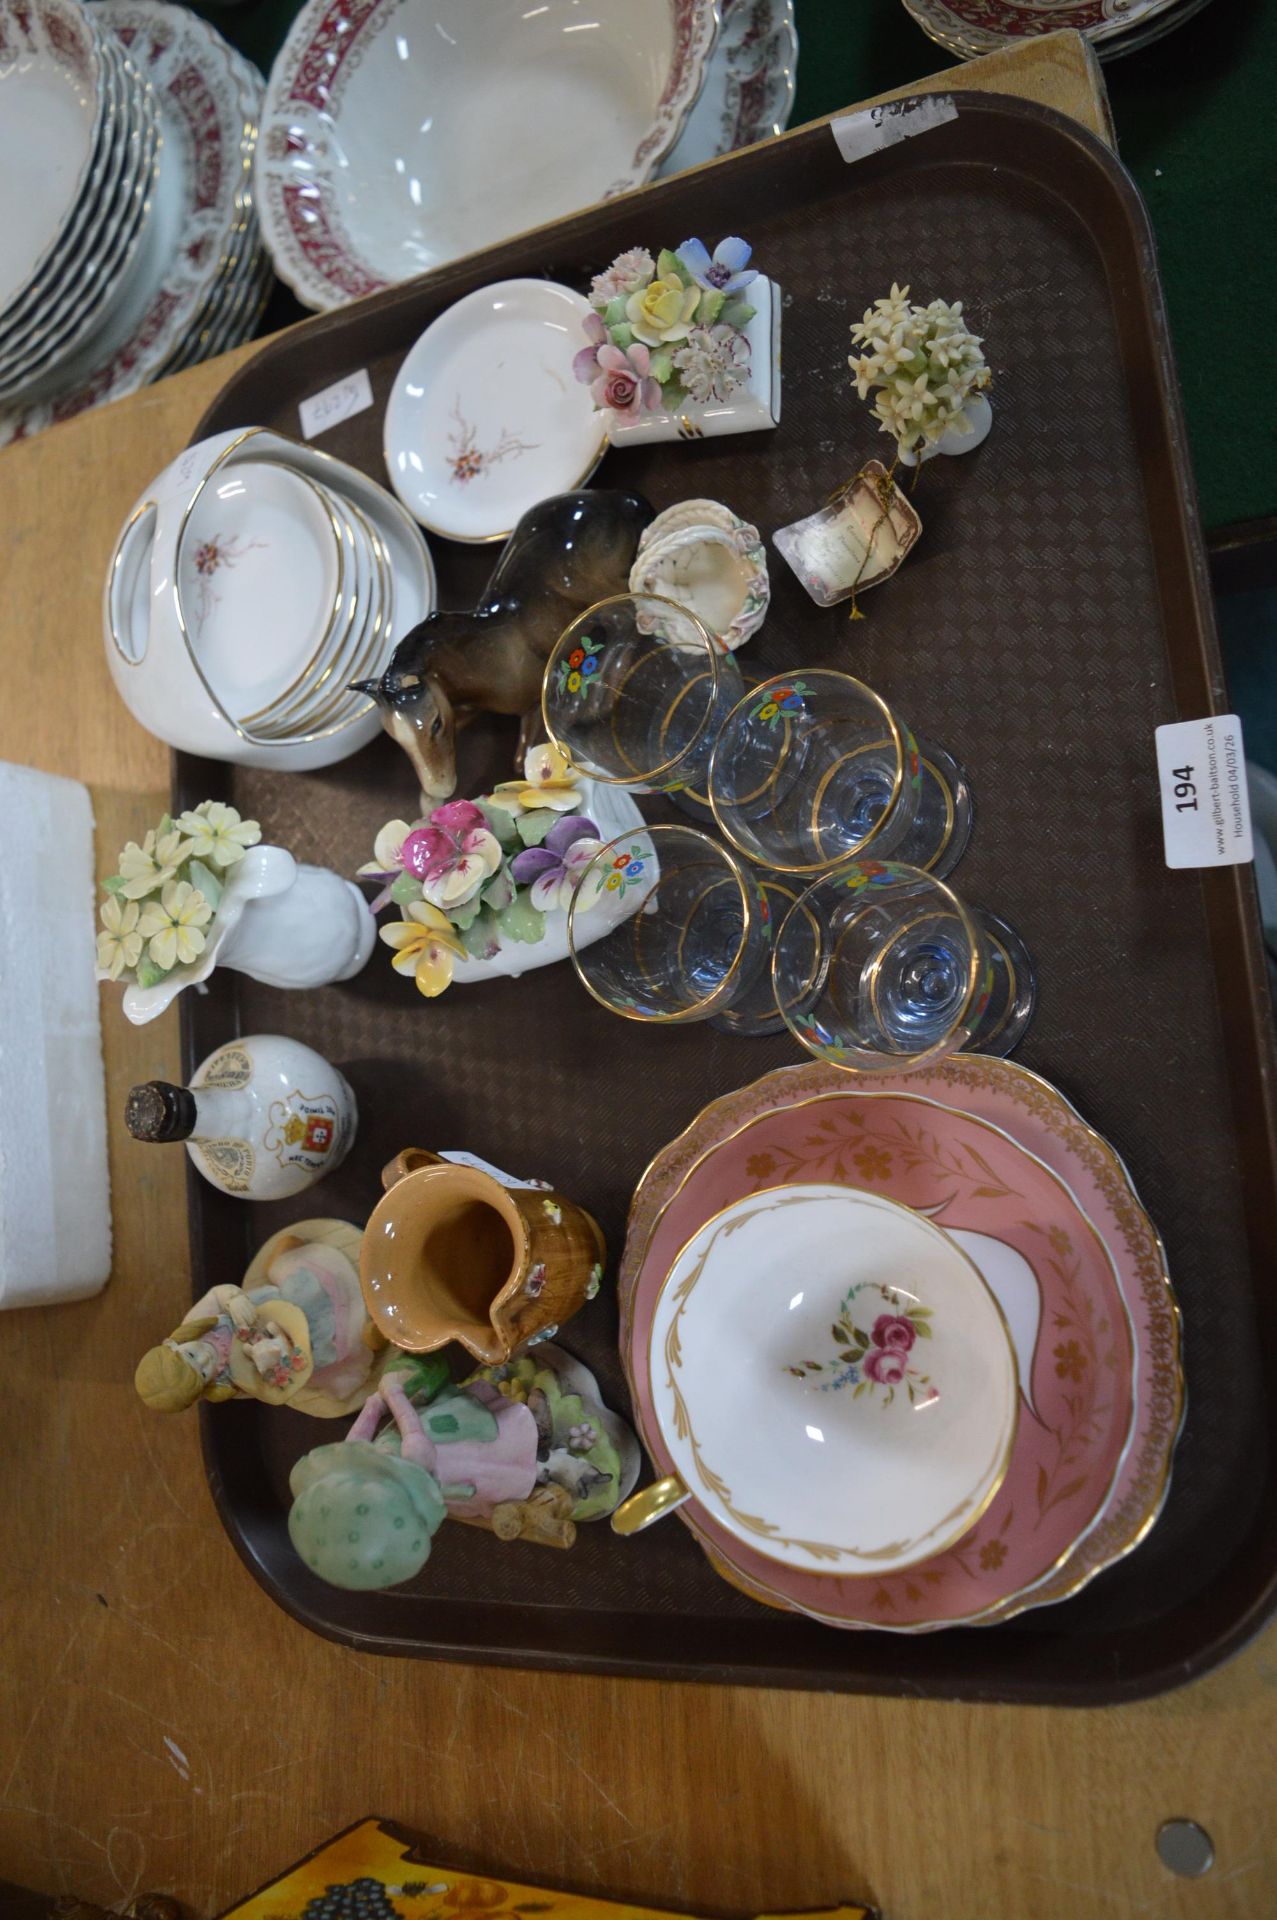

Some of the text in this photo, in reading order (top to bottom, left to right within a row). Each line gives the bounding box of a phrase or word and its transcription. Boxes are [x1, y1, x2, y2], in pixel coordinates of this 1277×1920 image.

[1172, 765, 1198, 813] 194
[1203, 723, 1226, 856] www.gilbert-baitson.co.uk
[1223, 734, 1243, 838] Household 04/03/26
